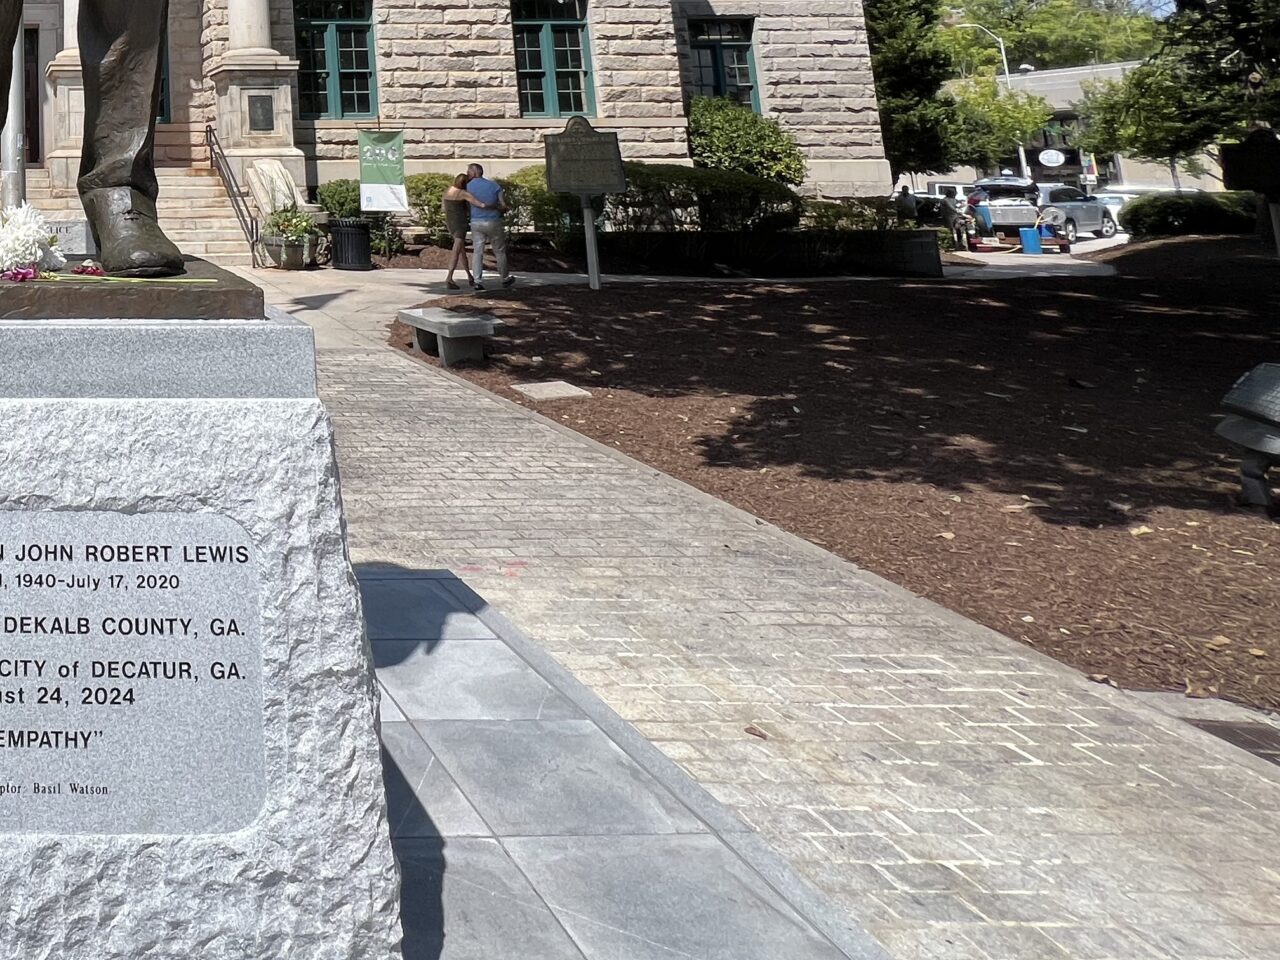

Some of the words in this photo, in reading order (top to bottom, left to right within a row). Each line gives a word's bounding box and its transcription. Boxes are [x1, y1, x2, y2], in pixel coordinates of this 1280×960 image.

[14, 543, 74, 562] JOHN
[85, 544, 173, 563] ROBERT
[183, 545, 249, 564] LEWIS
[15, 573, 101, 592] 1940-July
[107, 574, 129, 592] 17,
[136, 574, 180, 590] 2020
[3, 616, 91, 635] DEKALB
[101, 616, 198, 640] COUNTY,
[209, 617, 246, 637] GA.
[57, 660, 79, 679] of
[91, 660, 199, 684] DECATUR,
[210, 661, 246, 680] GA.
[36, 686, 69, 709] 24,
[81, 686, 136, 706] 2024
[33, 782, 61, 795] Basil
[69, 782, 109, 795] Watson
